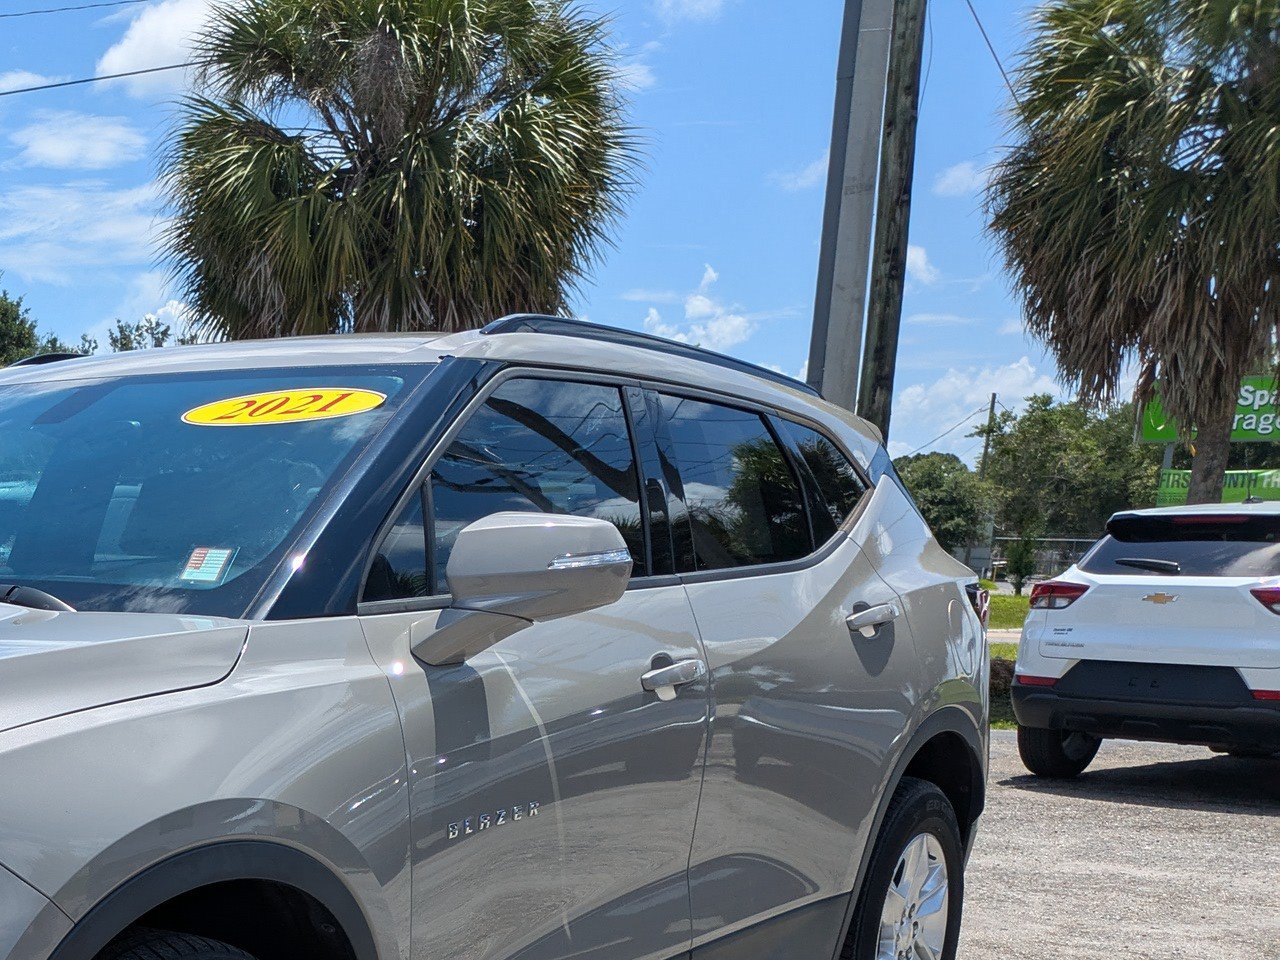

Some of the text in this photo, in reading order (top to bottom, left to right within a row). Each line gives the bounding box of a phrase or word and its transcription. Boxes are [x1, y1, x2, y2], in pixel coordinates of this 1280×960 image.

[211, 392, 355, 421] 2021
[1160, 472, 1191, 488] FIRS
[447, 801, 540, 839] BLAZER
